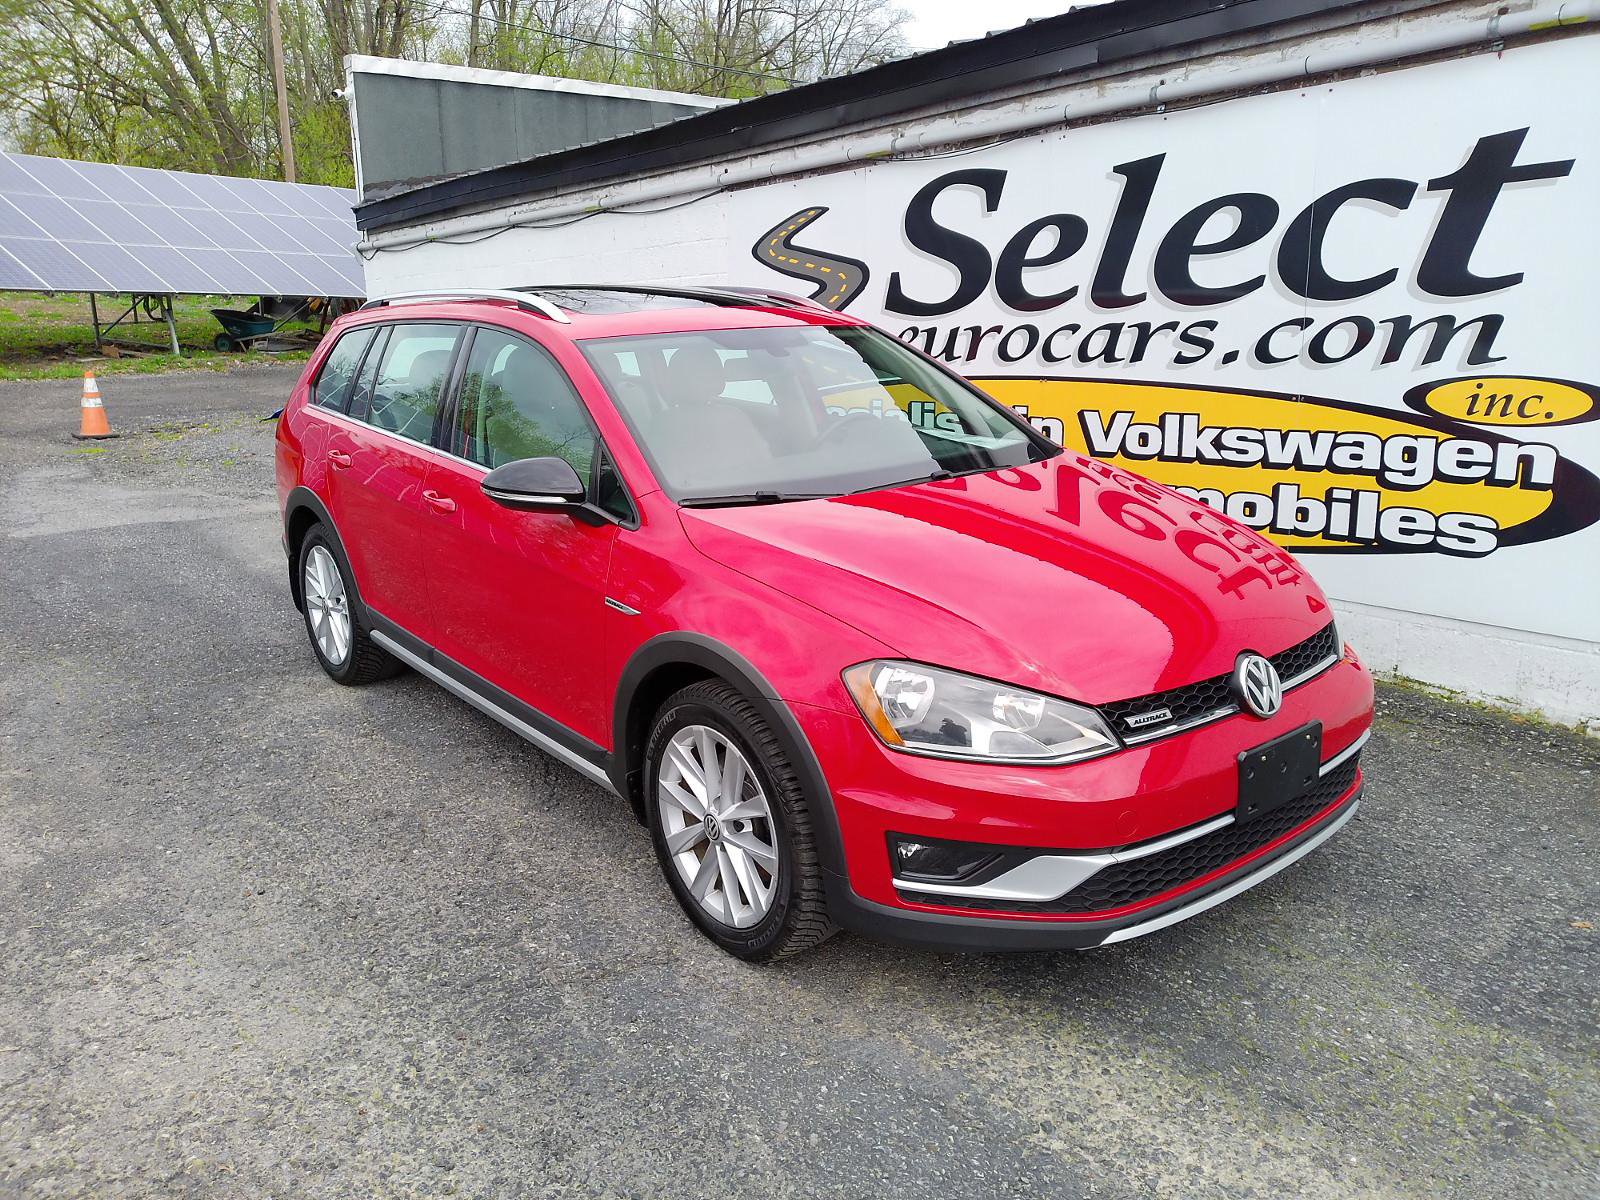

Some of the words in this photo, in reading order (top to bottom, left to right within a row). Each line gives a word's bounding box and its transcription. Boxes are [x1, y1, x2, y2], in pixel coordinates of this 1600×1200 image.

[884, 126, 1577, 316] Select
[898, 312, 1508, 366] eurocars.com
[1465, 382, 1555, 420] inc.
[1078, 410, 1560, 491] Volkswagen
[1133, 711, 1168, 726] ALLTRACK
